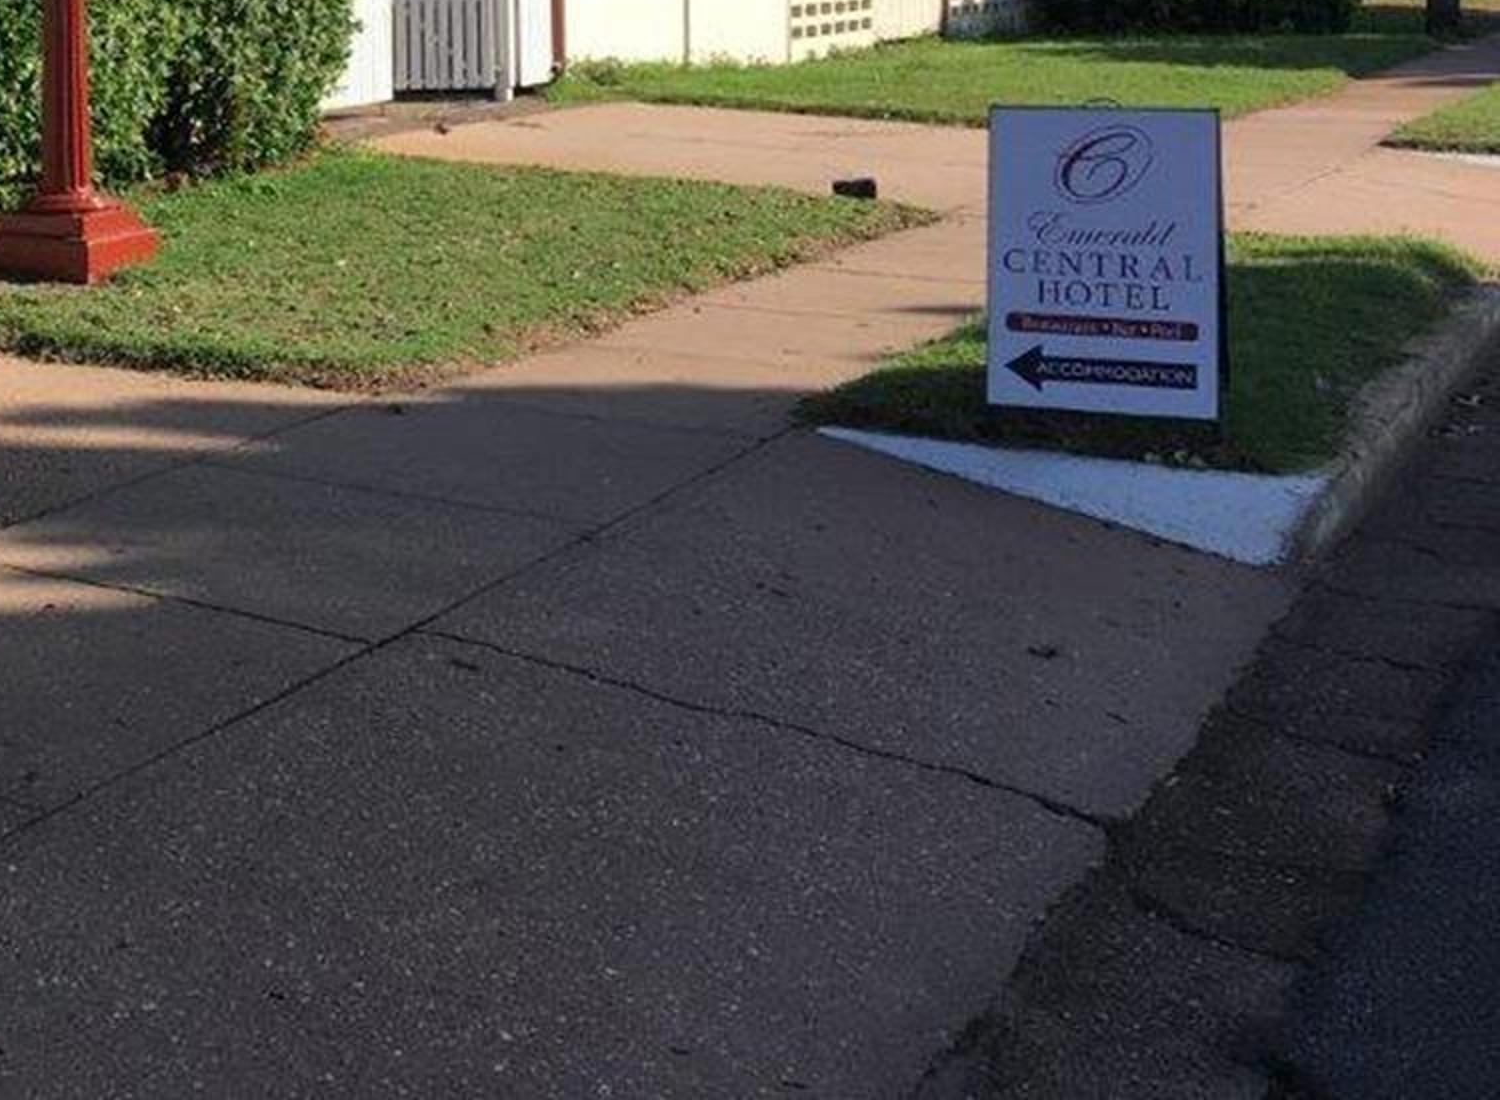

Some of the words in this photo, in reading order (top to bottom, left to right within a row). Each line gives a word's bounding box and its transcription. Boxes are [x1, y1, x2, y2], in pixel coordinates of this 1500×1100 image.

[1028, 211, 1177, 247] Emerald
[1003, 248, 1203, 283] CENTRAL
[1037, 278, 1172, 311] HOTEL
